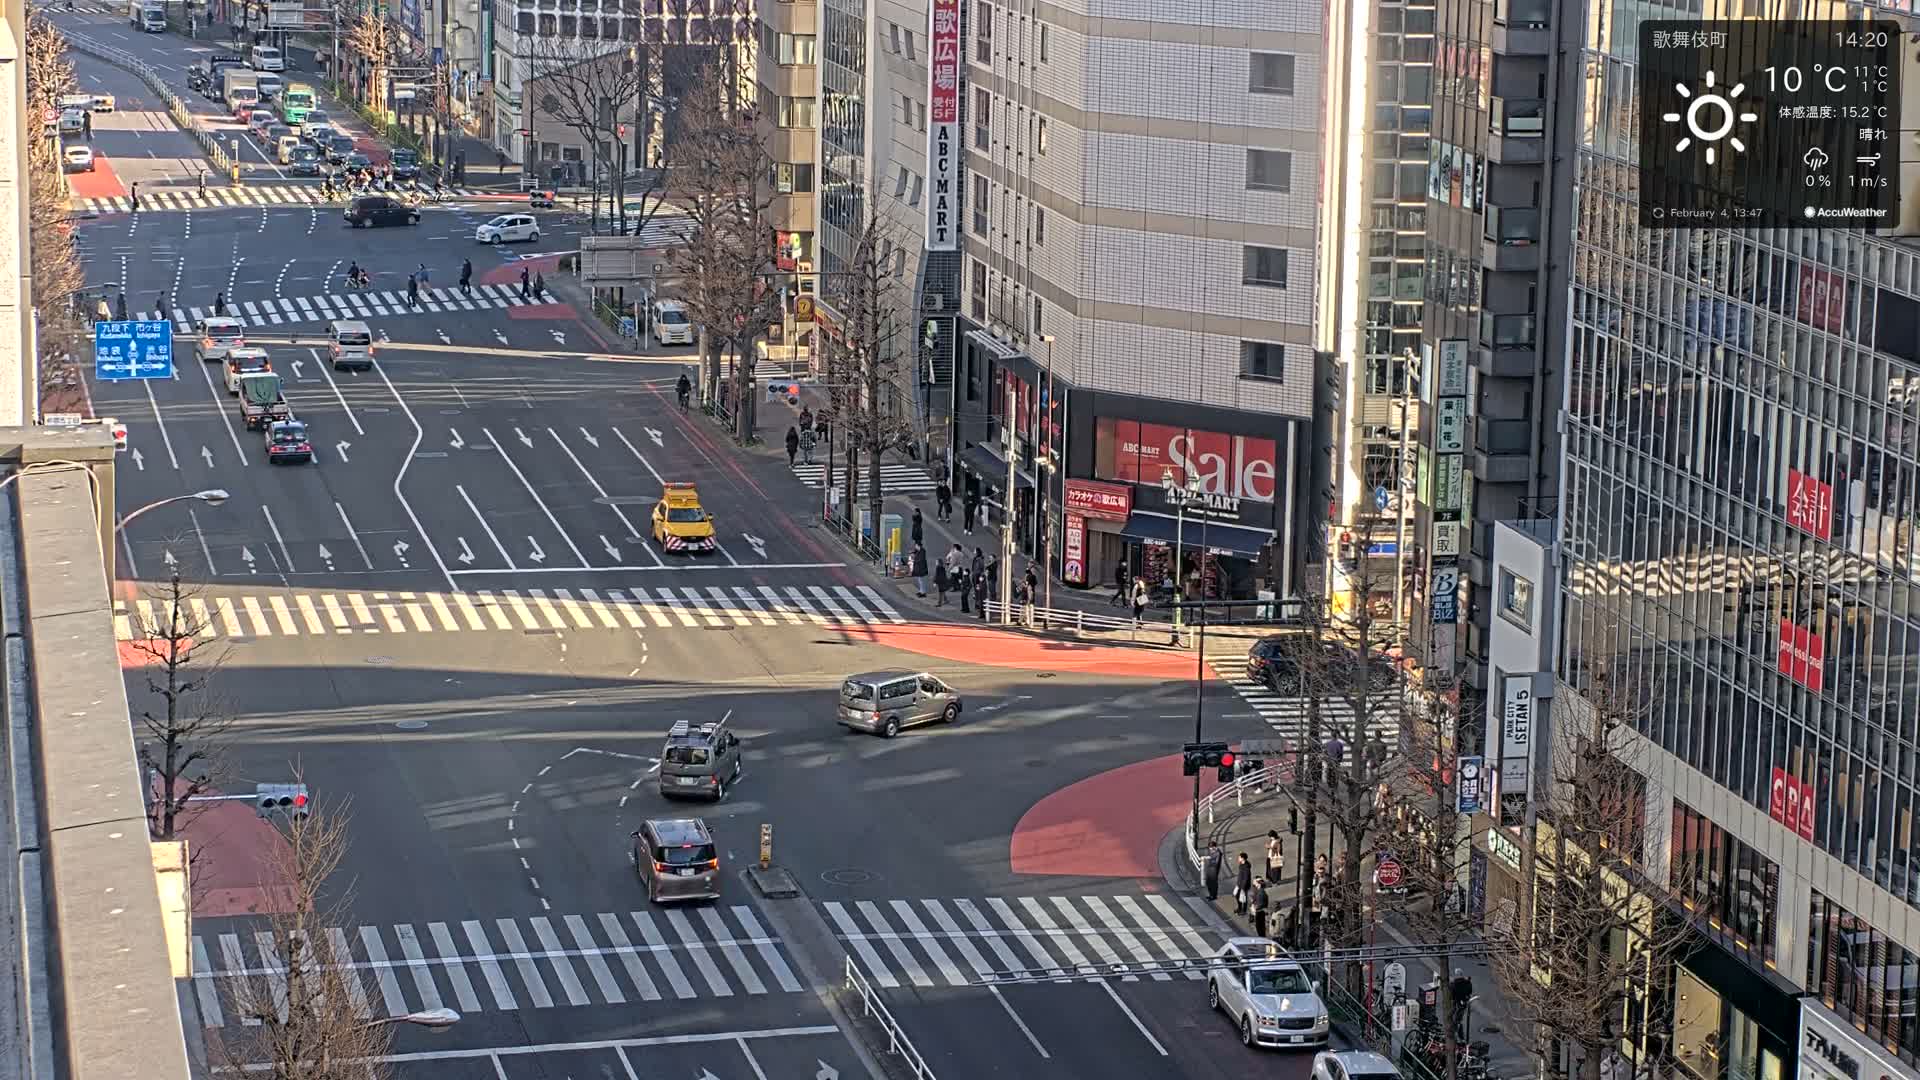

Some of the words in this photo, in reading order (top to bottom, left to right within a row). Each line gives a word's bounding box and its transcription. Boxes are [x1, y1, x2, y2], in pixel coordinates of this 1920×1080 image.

[935, 9, 956, 90] 歌広場
[933, 96, 955, 108] 受付
[933, 109, 955, 119] 5F
[936, 126, 949, 242] ABC-MART
[102, 323, 130, 333] 九段下
[1122, 442, 1160, 455] ABCMART
[1168, 434, 1275, 503] Sale
[1068, 489, 1093, 502] カラオケ
[1792, 482, 1828, 529] 会計
[1437, 525, 1450, 552] 買取
[1436, 574, 1453, 592] B
[1517, 689, 1529, 700] 5
[1507, 701, 1516, 716] CITY
[1506, 718, 1514, 738] PARK
[1515, 704, 1528, 745] ISETAN
[1774, 779, 1812, 827] CPA
